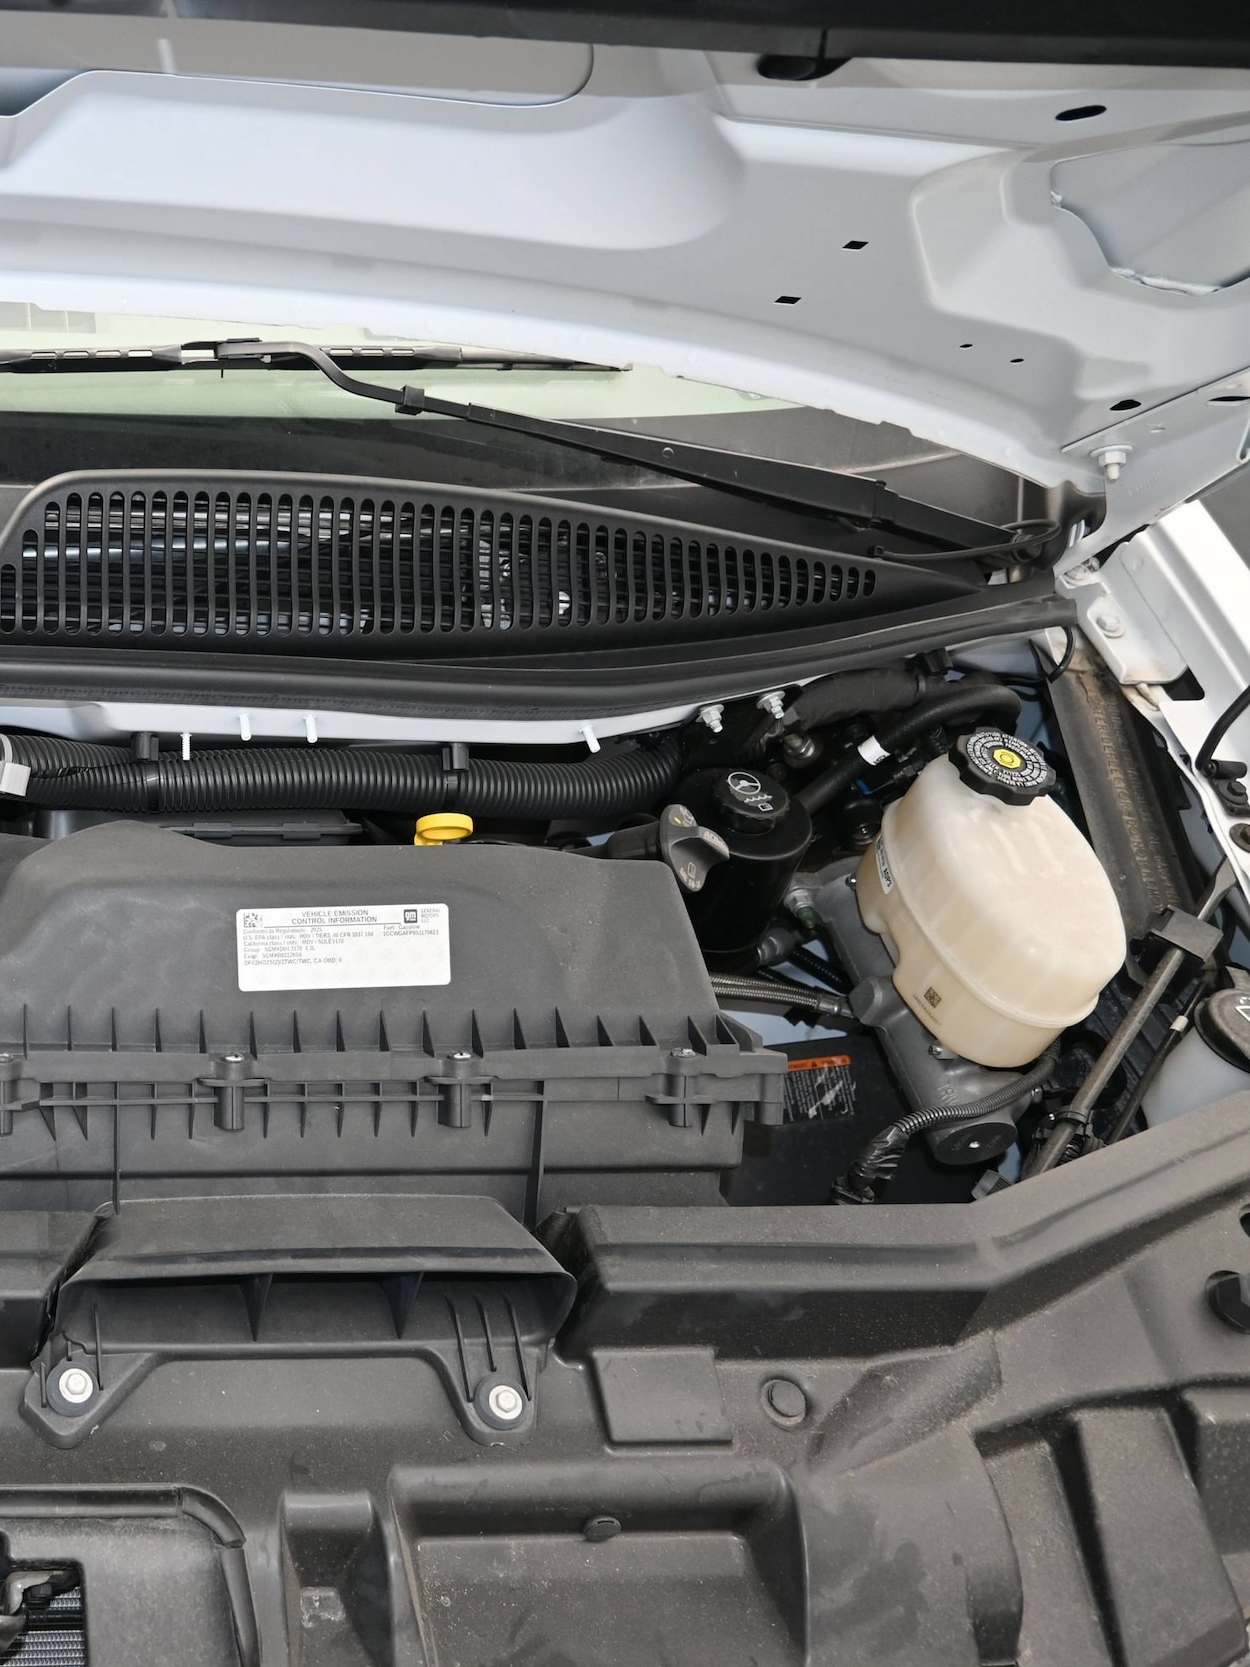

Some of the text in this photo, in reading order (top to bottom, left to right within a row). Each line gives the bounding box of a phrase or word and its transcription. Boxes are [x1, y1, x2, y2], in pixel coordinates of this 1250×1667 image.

[301, 910, 332, 918] VEHICLE
[291, 916, 378, 925] CONTROL INFORMATION
